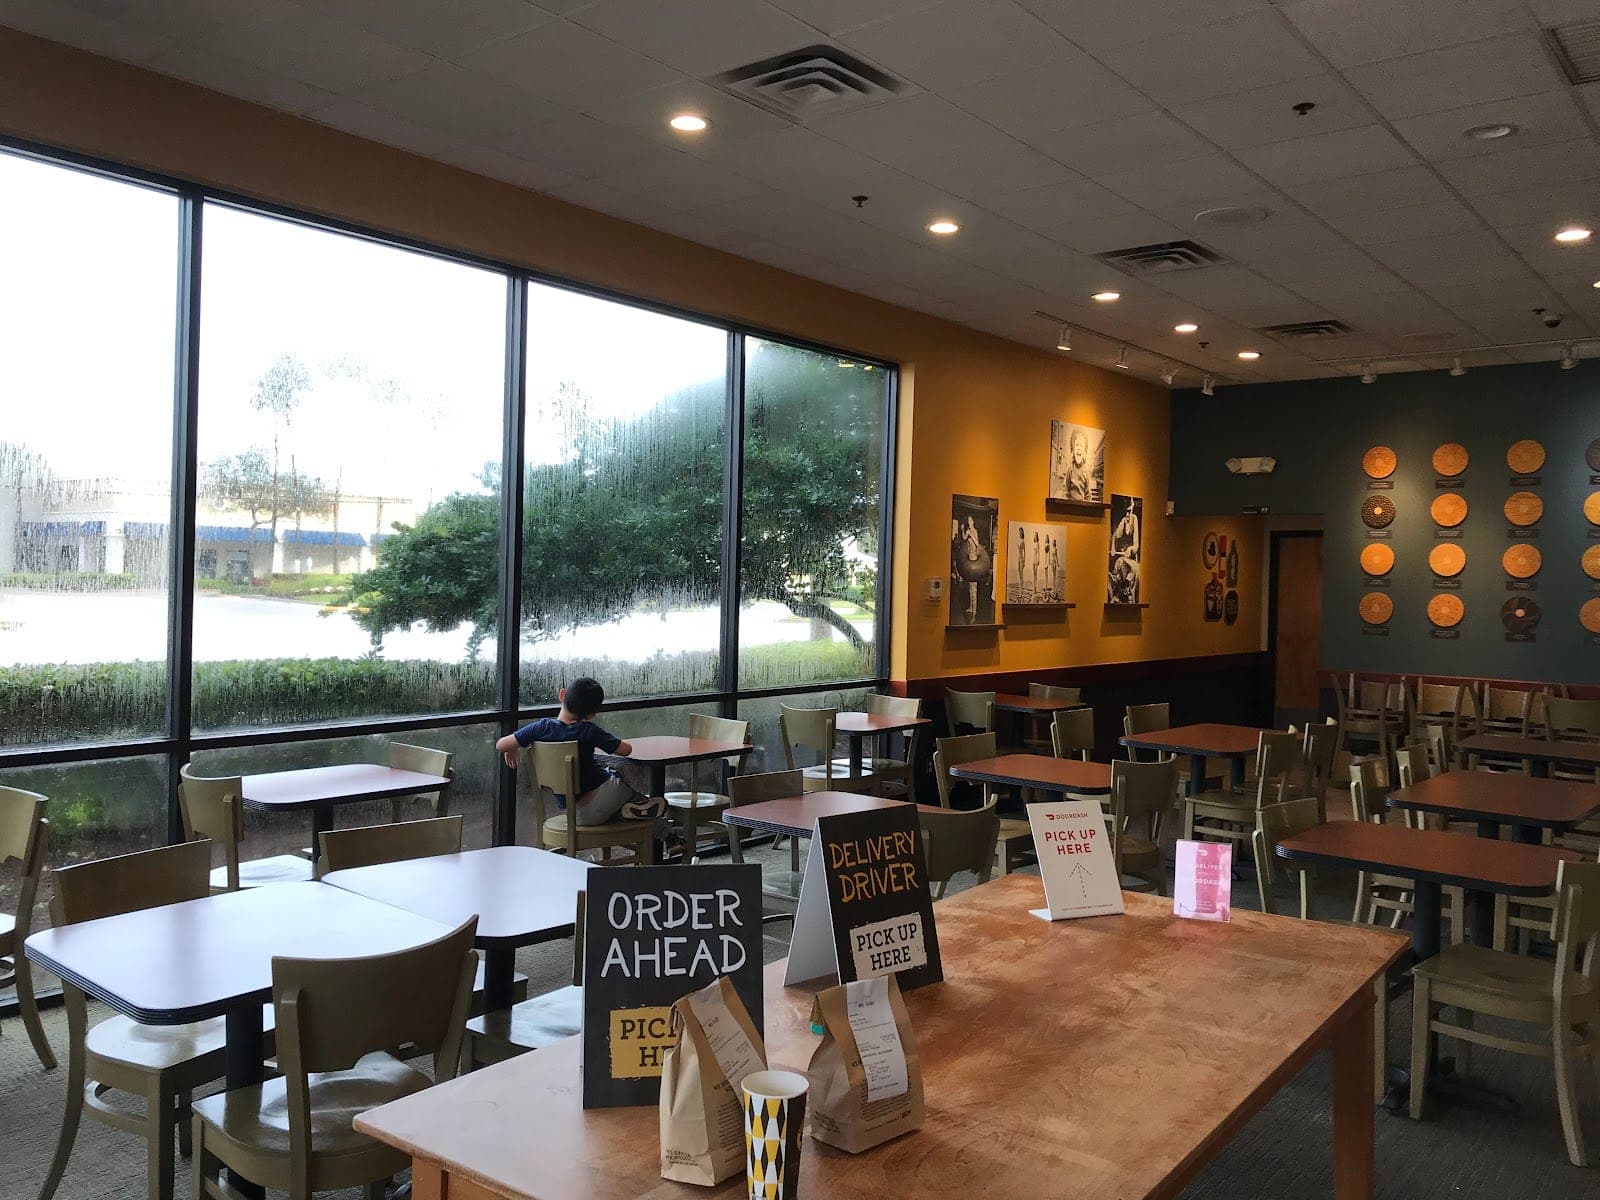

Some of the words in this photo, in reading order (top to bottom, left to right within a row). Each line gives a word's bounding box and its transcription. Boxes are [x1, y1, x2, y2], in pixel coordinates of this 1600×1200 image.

[829, 830, 916, 869] DELIVERY
[1045, 830, 1076, 842] PICK
[1080, 829, 1096, 840] UP
[1056, 842, 1092, 855] HERE
[839, 862, 919, 903] DRIVER
[607, 889, 744, 931] ORDER
[857, 927, 895, 952] PICK
[899, 922, 918, 941] UP
[600, 934, 747, 979] AHEAD
[870, 945, 912, 971] HERE
